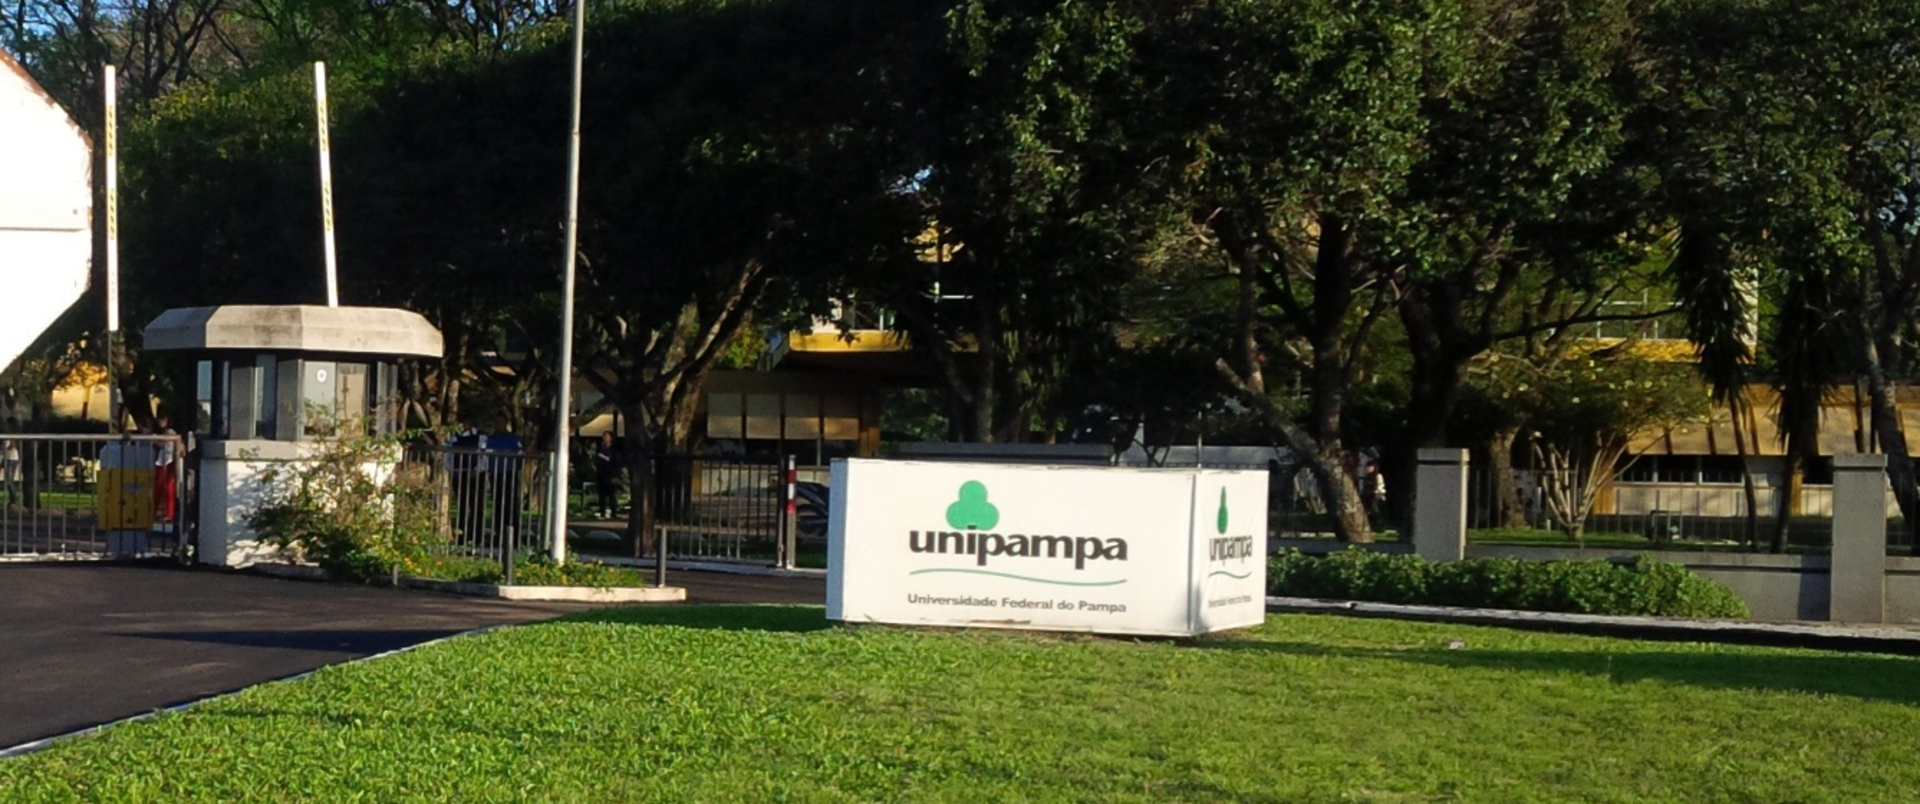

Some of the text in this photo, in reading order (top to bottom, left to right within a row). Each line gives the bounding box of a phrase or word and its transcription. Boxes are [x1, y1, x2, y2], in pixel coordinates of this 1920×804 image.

[909, 526, 1128, 570] unipampa
[907, 593, 1127, 614] Universidade Federal do Pampa
